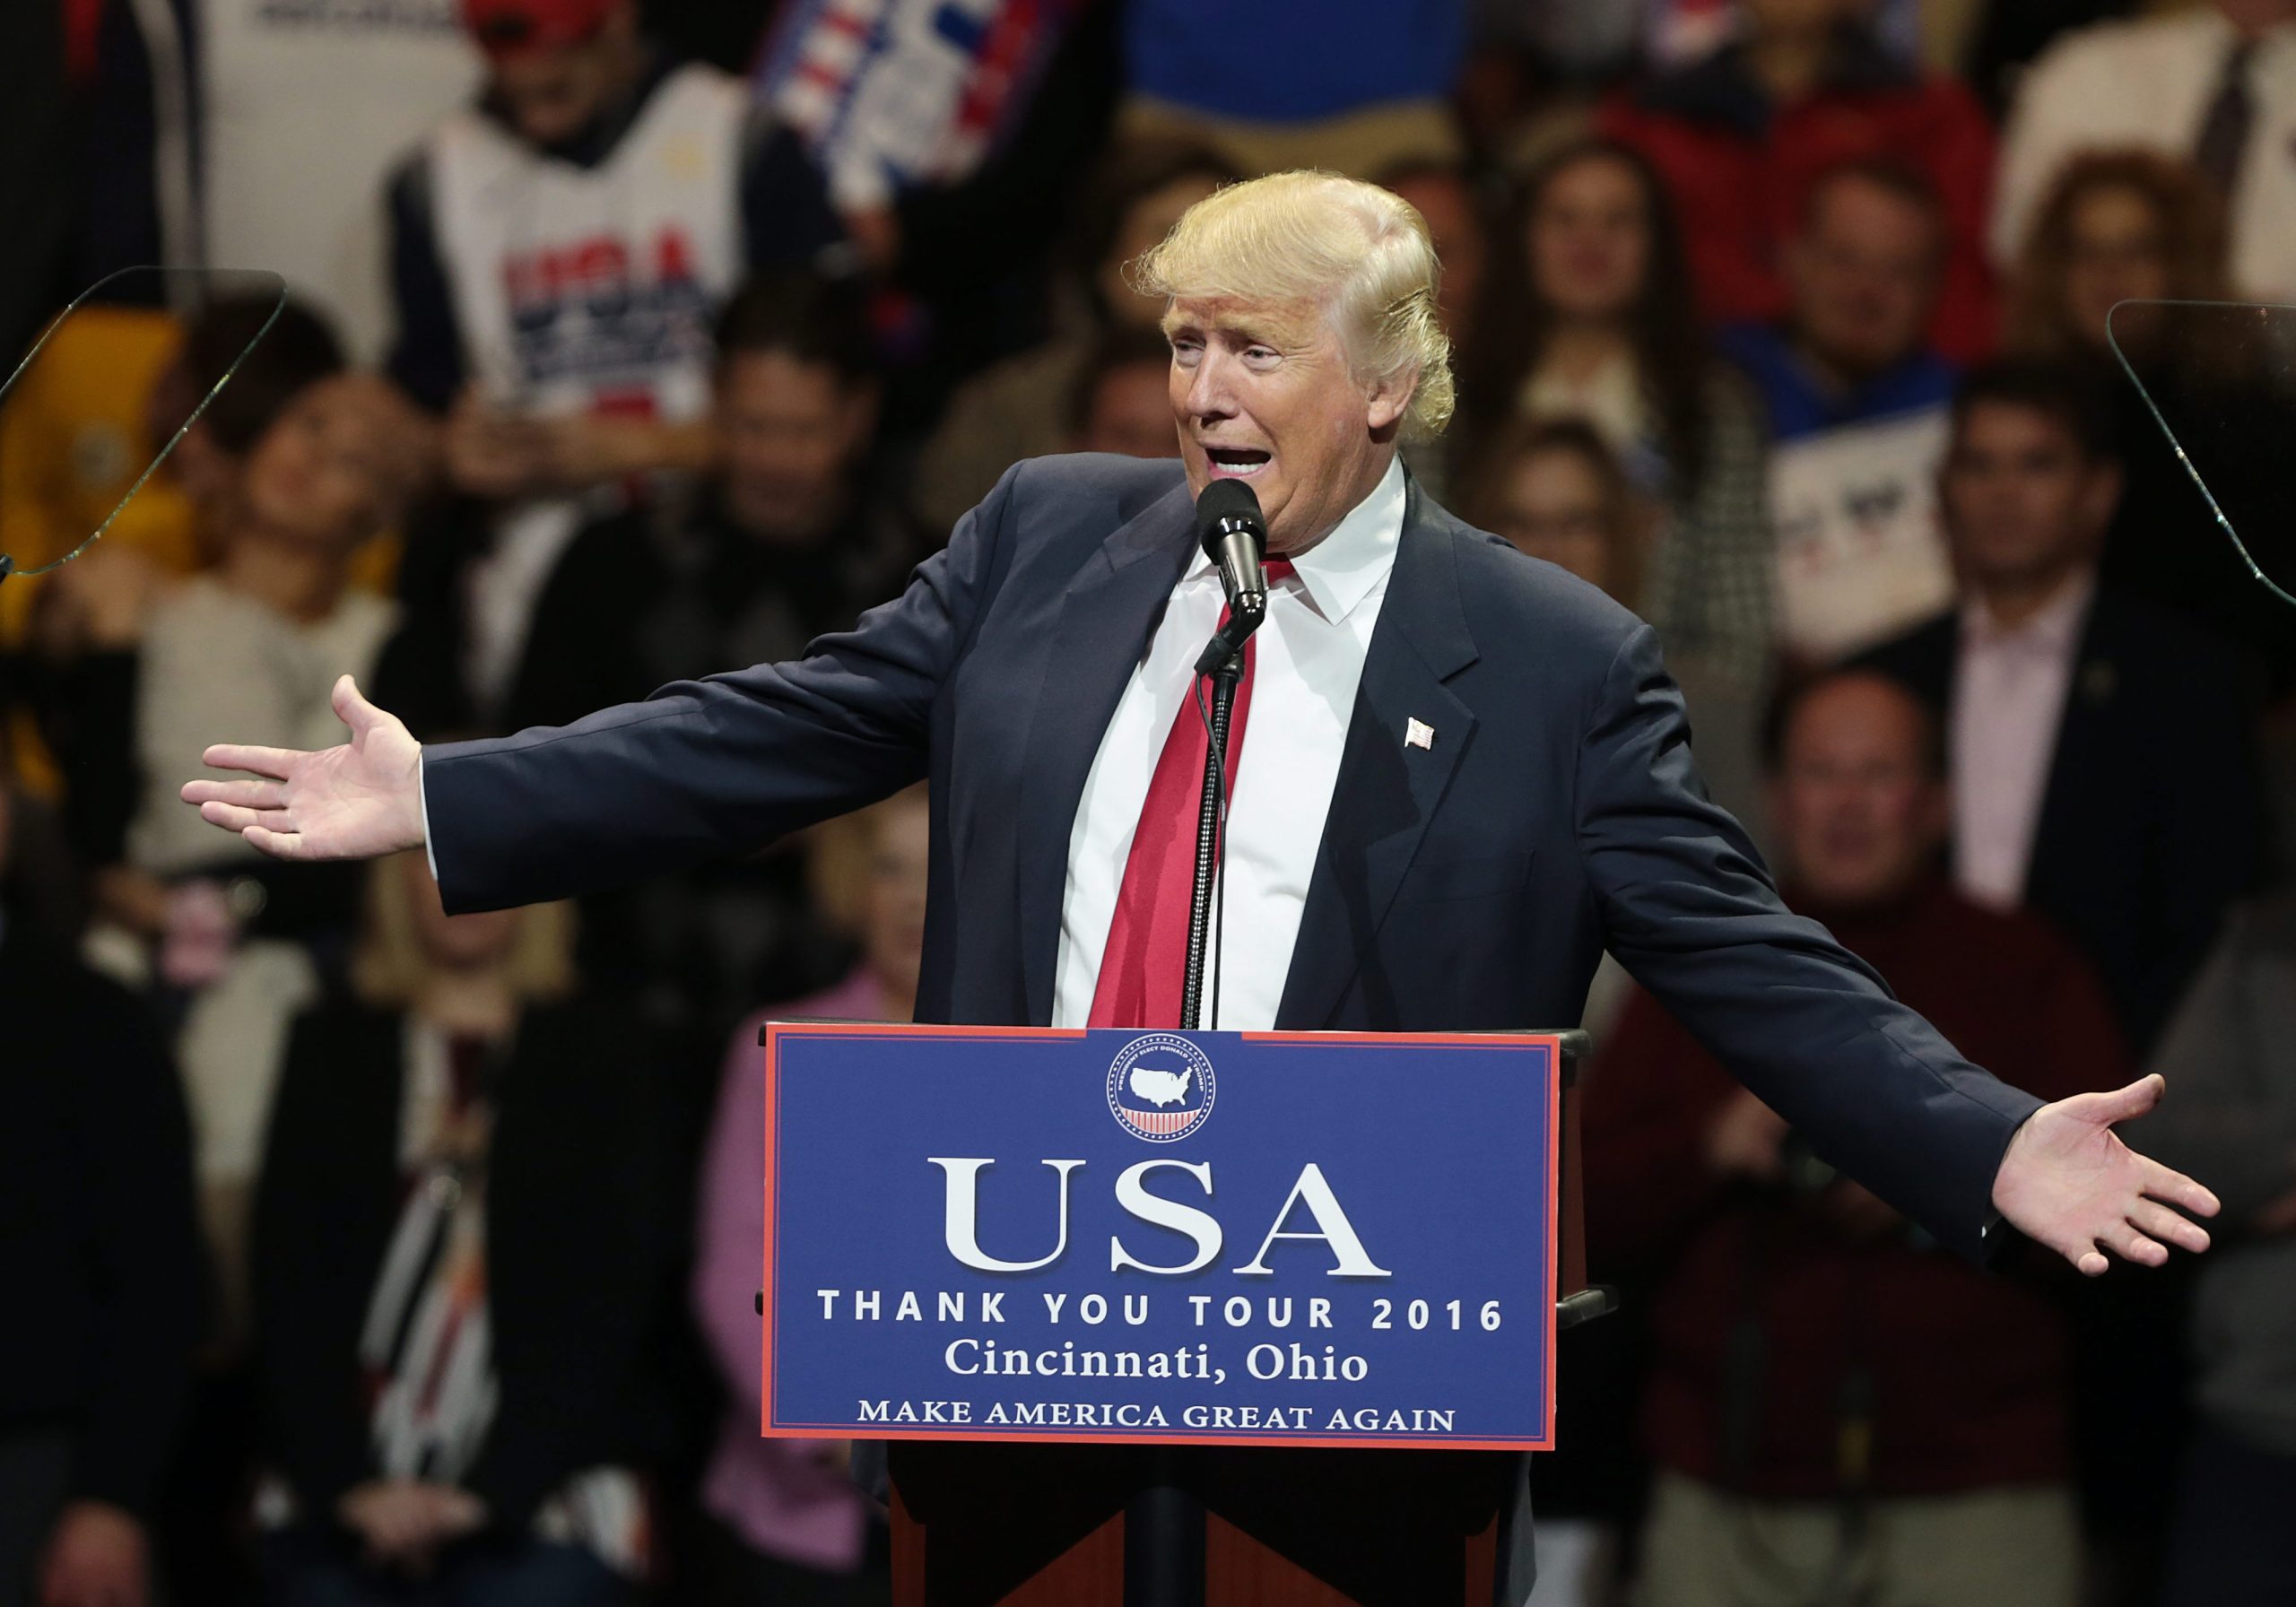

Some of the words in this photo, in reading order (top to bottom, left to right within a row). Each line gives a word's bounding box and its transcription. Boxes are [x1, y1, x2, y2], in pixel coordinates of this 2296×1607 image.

[1118, 1053, 1138, 1090] PRESIDENT
[1139, 1046, 1159, 1055] ELECT
[1161, 1046, 1188, 1058] DONALD
[1193, 1064, 1204, 1091] TRUMP
[927, 1158, 1392, 1277] USA
[817, 1290, 1005, 1323] THANK
[1043, 1293, 1148, 1325] YOU
[1188, 1296, 1334, 1328] TOUR
[1371, 1299, 1502, 1332] 2016
[944, 1338, 1227, 1385] Cincinnati,
[1246, 1342, 1369, 1382] Ohio
[857, 1400, 972, 1424] MAKE
[984, 1402, 1170, 1428] AMERICA
[1182, 1405, 1314, 1430] GREAT
[1325, 1408, 1456, 1433] AGAIN
